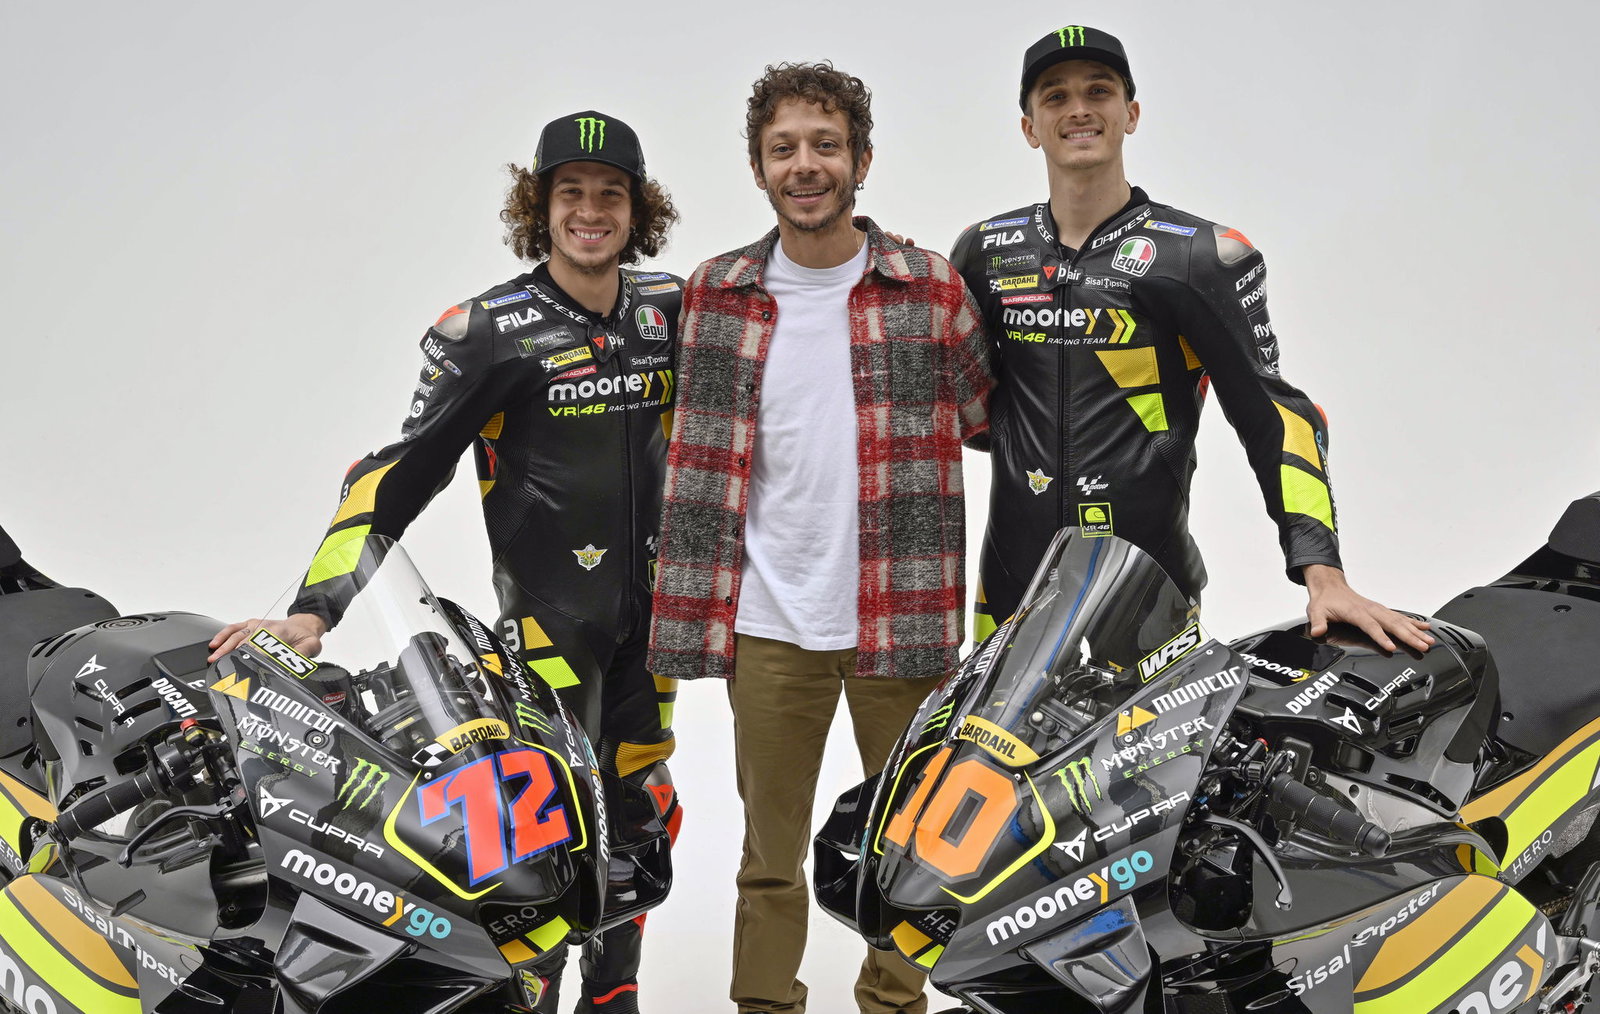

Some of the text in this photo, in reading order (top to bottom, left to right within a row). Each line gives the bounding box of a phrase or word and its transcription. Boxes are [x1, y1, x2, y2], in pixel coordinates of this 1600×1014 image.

[983, 230, 1025, 249] FILA
[1091, 207, 1152, 250] DAINESE
[1002, 276, 1036, 288] BARDAHL
[1235, 262, 1267, 291] DAINE
[495, 307, 543, 332] FILA
[525, 284, 590, 324] DAINESE
[1002, 295, 1051, 305] BARRACUDA
[1003, 307, 1102, 335] mooney
[1083, 337, 1107, 345] TEAM
[553, 347, 590, 363] BARDAHL
[548, 371, 654, 401] mooney
[608, 403, 640, 413] RACNG
[641, 400, 660, 408] TEAM
[252, 630, 314, 675] WRS
[1141, 626, 1198, 679] WRS
[1240, 652, 1310, 683] mooney
[94, 678, 136, 728] CUPRA
[151, 677, 198, 718] DUCATI
[1285, 671, 1340, 715] DUCATI
[1364, 667, 1416, 711] CUPRA
[237, 712, 342, 775] MONSTER
[449, 723, 506, 752] BARDAHL
[961, 722, 1016, 760] BARDAHL
[1100, 716, 1215, 771] MONSTER
[239, 740, 318, 777] ENERGY
[1123, 739, 1204, 779] ENERGY
[288, 808, 385, 859] CUPRA
[417, 747, 573, 887] 72
[883, 746, 1020, 882] 10
[1093, 790, 1190, 842] CUPRA
[0, 838, 24, 871] ERO
[1512, 829, 1552, 875] HERO
[280, 849, 452, 939] mooneygo
[986, 850, 1154, 946] mooneygo
[489, 906, 538, 935] ERO
[1453, 921, 1546, 1014] ney
